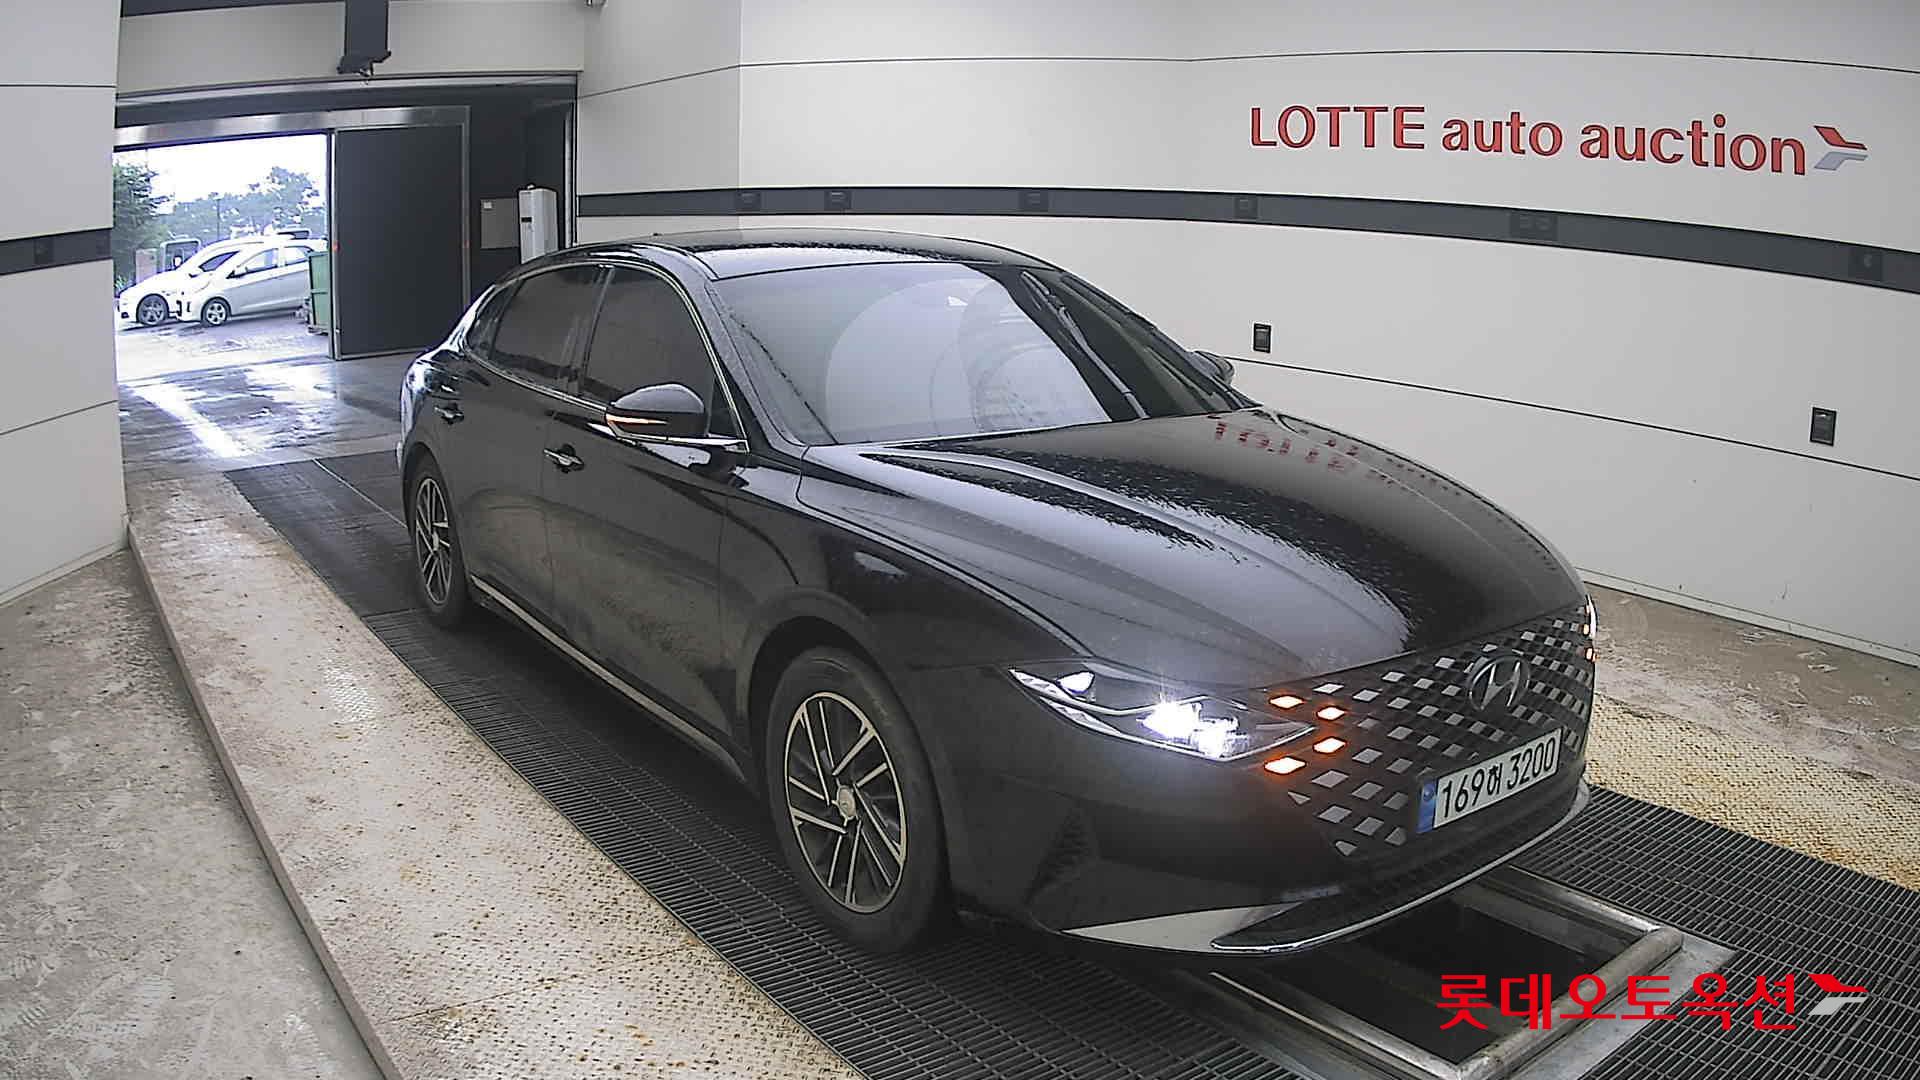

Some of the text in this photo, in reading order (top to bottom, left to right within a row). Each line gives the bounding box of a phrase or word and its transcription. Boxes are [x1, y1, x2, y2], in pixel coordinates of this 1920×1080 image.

[1250, 106, 1807, 175] LOTTE auto auction
[1442, 737, 1556, 818] 169허 3200
